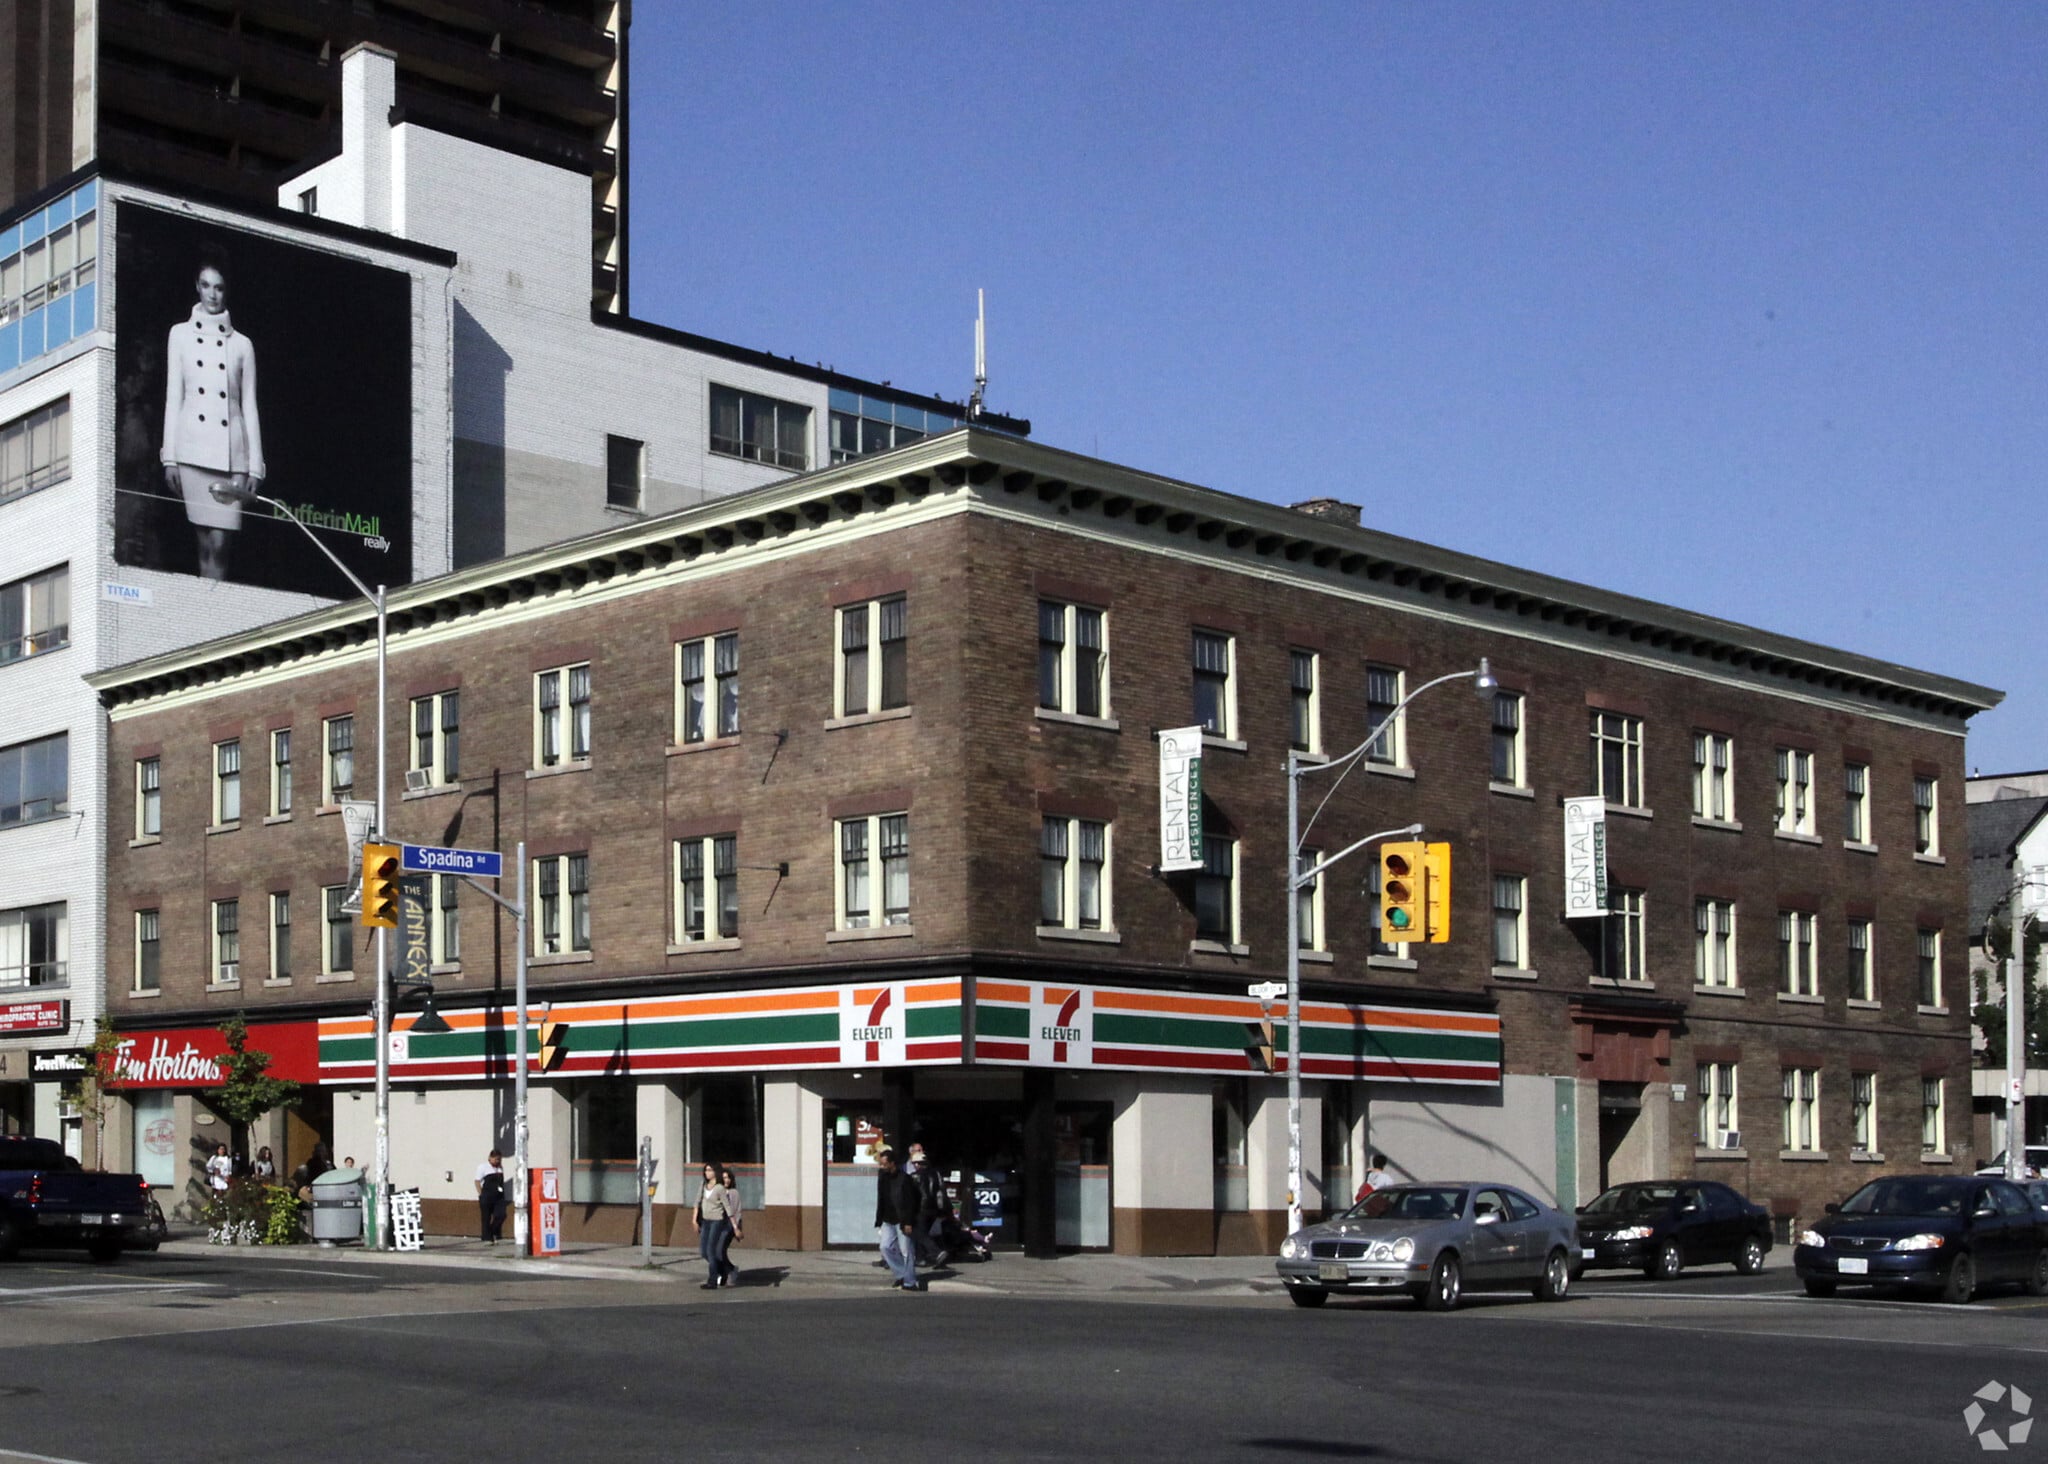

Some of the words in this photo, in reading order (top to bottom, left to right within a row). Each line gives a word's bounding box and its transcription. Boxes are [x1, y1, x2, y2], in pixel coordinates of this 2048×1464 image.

[273, 498, 380, 537] DufferinMall
[364, 536, 391, 553] really
[107, 584, 140, 600] TITAN
[1166, 759, 1185, 861] RENTAL
[1190, 761, 1200, 857] RESIDENCES
[419, 848, 474, 869] Spadina
[477, 855, 486, 864] Rd
[1571, 824, 1591, 909] RENTAL
[1595, 824, 1606, 907] RESIDENCES
[403, 885, 421, 896] THE
[404, 898, 428, 978] ANNEX
[38, 1010, 58, 1020] CLINIC
[866, 987, 891, 1062] 7
[1053, 989, 1080, 1062] 7
[113, 1038, 145, 1082] Tim
[147, 1036, 221, 1081] Hortons
[974, 1190, 1000, 1205] $20
